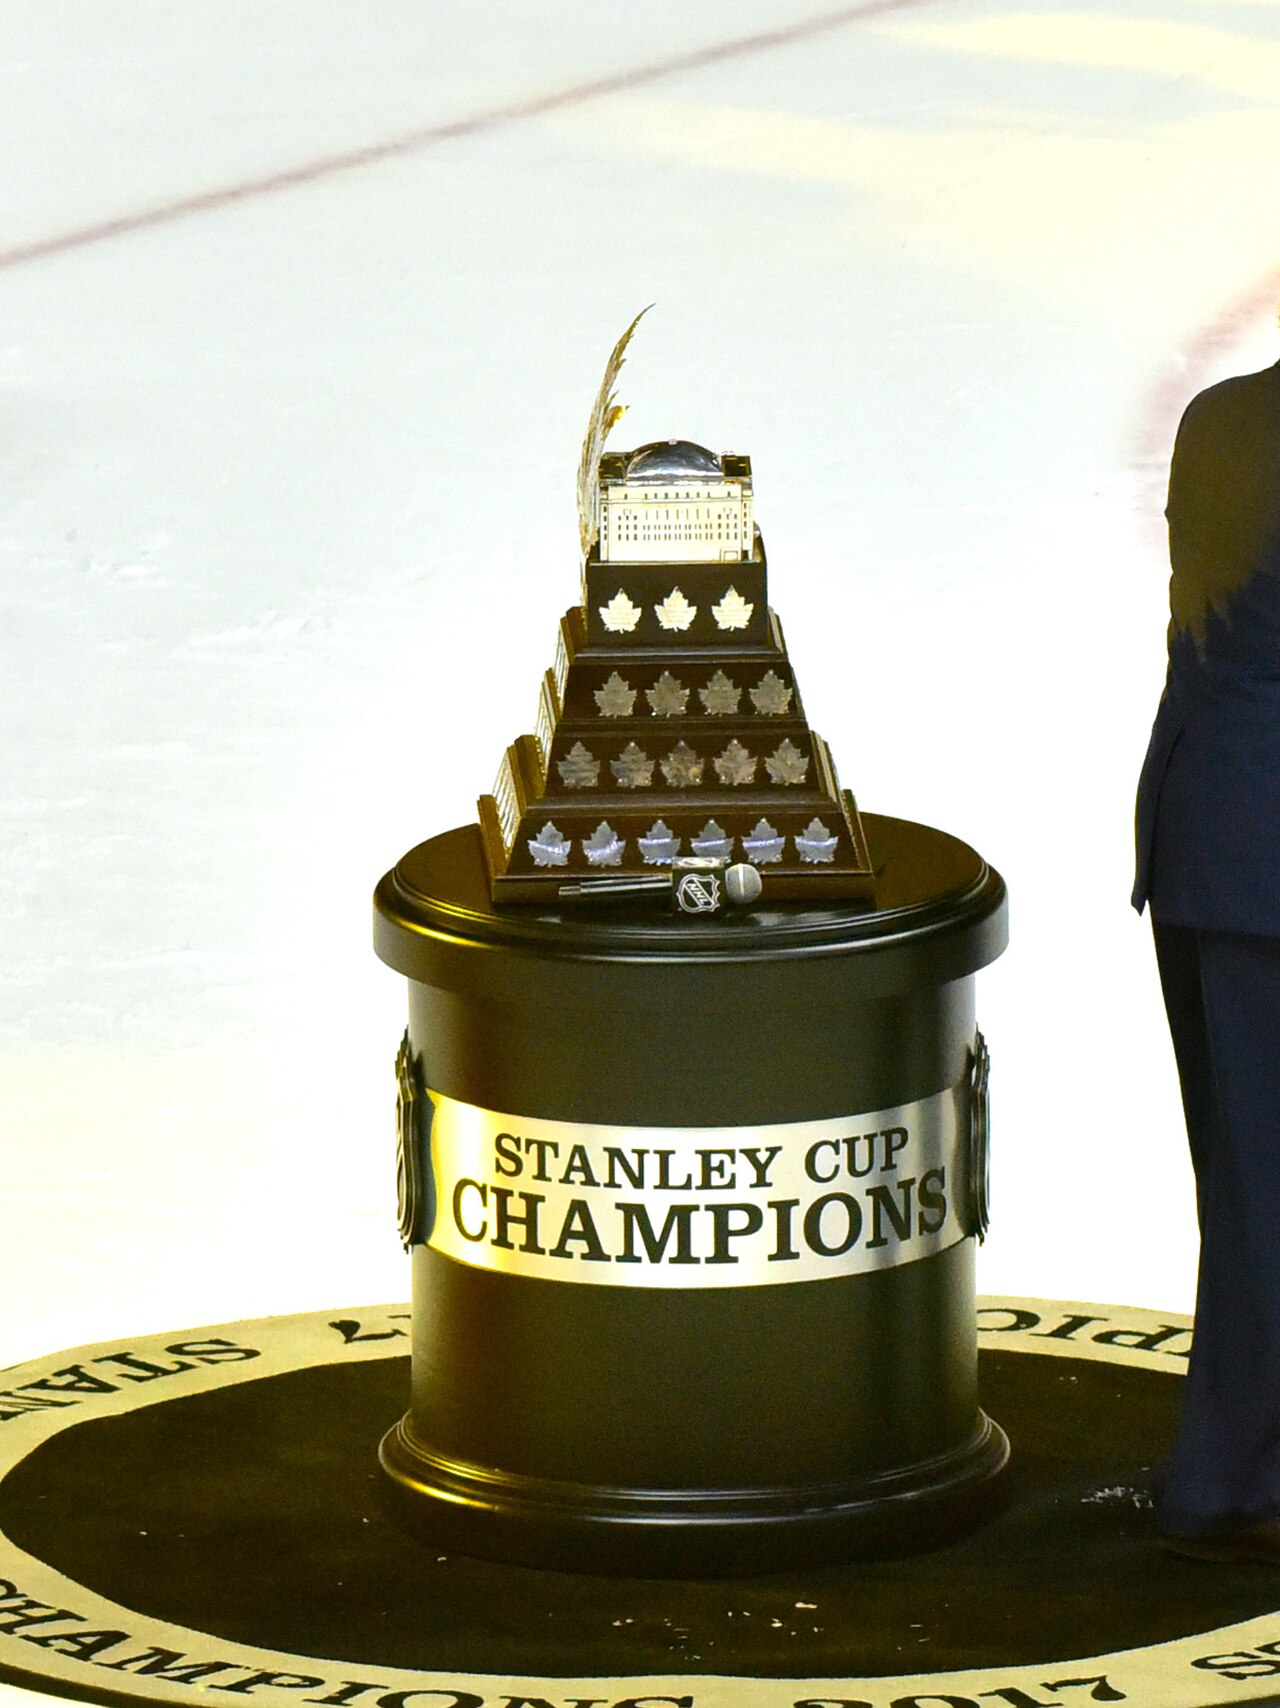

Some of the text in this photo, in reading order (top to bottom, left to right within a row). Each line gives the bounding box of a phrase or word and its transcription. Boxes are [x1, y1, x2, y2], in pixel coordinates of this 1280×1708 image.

[687, 882, 709, 905] NHL
[494, 1126, 909, 1191] STANLEY CUP
[452, 1165, 948, 1265] CHAMPIONS
